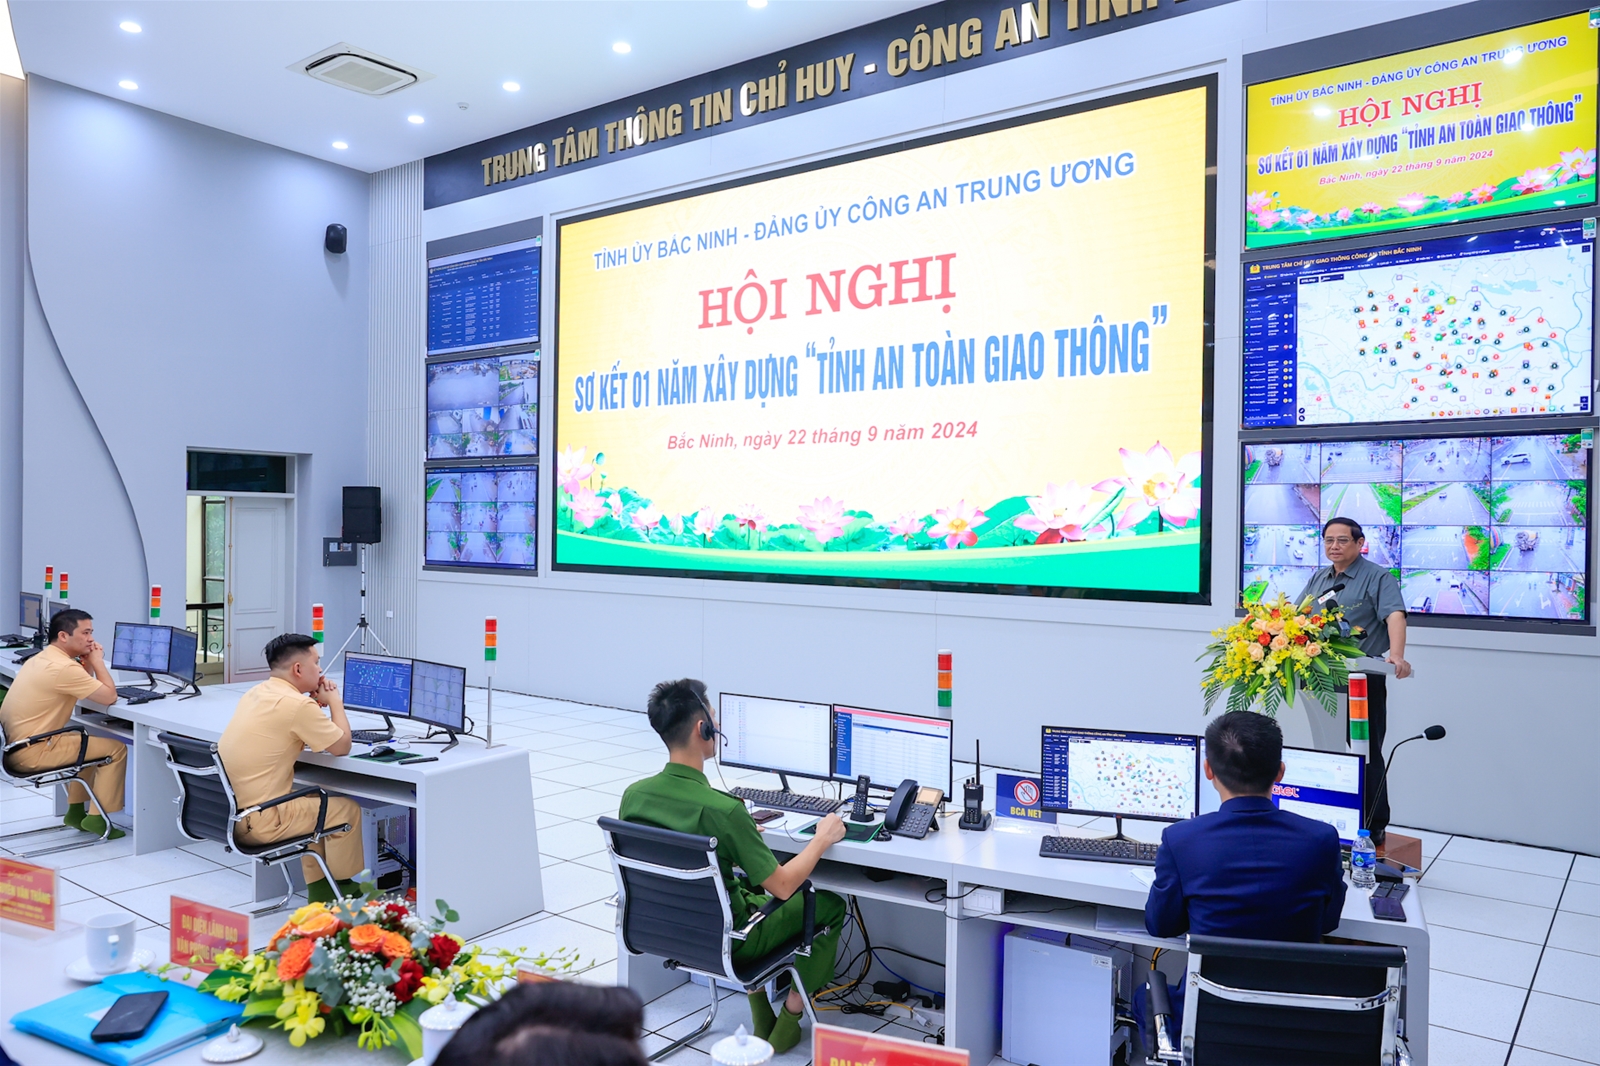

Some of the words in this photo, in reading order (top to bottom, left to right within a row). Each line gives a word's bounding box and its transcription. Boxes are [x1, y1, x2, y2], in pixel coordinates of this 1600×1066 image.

[481, 142, 548, 186] TRUNG
[552, 127, 599, 167] TÂM
[604, 105, 683, 153] THÔNG
[690, 88, 732, 130] TIN
[740, 59, 787, 117] CHỈ
[795, 53, 855, 102] HUY
[887, 17, 983, 76] CÔNG
[995, 0, 1048, 49] AN
[1271, 94, 1294, 106] TỈNH
[1296, 90, 1310, 101] ỦY
[1312, 83, 1335, 98] BẮC
[1337, 80, 1363, 93] NINH
[1371, 71, 1404, 86] ĐẢNG
[1406, 66, 1422, 79] ỦY
[1424, 59, 1459, 75] CÔNG
[1461, 55, 1478, 67] AN
[1527, 36, 1568, 53] ƯƠNG
[1338, 97, 1392, 128] HỘI
[1401, 82, 1482, 117] NGHỊ
[1258, 153, 1273, 175] SƠ
[1275, 146, 1294, 172] KẾT
[1296, 150, 1309, 169] 01
[1312, 142, 1338, 166] NĂM
[1341, 137, 1363, 161] XÂY
[1366, 133, 1398, 159] DỰNG
[1438, 123, 1456, 144] AN
[1459, 114, 1492, 141] TOÀN
[1496, 109, 1526, 135] GIAO
[1319, 174, 1337, 185] Bắc
[1366, 168, 1389, 179] ngày
[1391, 165, 1403, 173] 22
[1405, 161, 1433, 172] tháng
[1435, 158, 1442, 167] 9
[1444, 155, 1466, 165] năm
[1469, 149, 1493, 161] 2024
[594, 246, 628, 270] TỈNH
[632, 241, 653, 263] ỦY
[658, 233, 692, 258] BẮC
[697, 227, 738, 251] NINH
[754, 213, 809, 241] ĐẢNG
[815, 205, 842, 230] ỦY
[847, 195, 910, 224] CÔNG
[916, 187, 948, 212] AN
[955, 169, 1041, 204] TRUNG
[1050, 152, 1135, 188] ƯƠNG
[698, 268, 788, 335] HỘI
[805, 253, 957, 315] NGHỊ
[1262, 263, 1280, 271] TRUNG
[574, 371, 596, 413] SƠ
[599, 360, 628, 411] KẾT
[632, 370, 650, 408] 01
[657, 358, 697, 406] NĂM
[703, 354, 739, 403] XÂY
[744, 353, 798, 408] DỰNG
[872, 344, 904, 391] AN
[912, 330, 975, 388] TOÀN
[984, 331, 1045, 383] GIAO
[667, 431, 695, 450] Bắc
[699, 433, 738, 450] Ninh,
[743, 430, 783, 451] ngày
[787, 429, 807, 445] 22
[811, 426, 862, 447] tháng
[867, 424, 878, 442] 9
[883, 422, 924, 441] năm
[931, 420, 978, 439] 2024
[1010, 806, 1026, 817] BCA
[1027, 808, 1043, 819] NET
